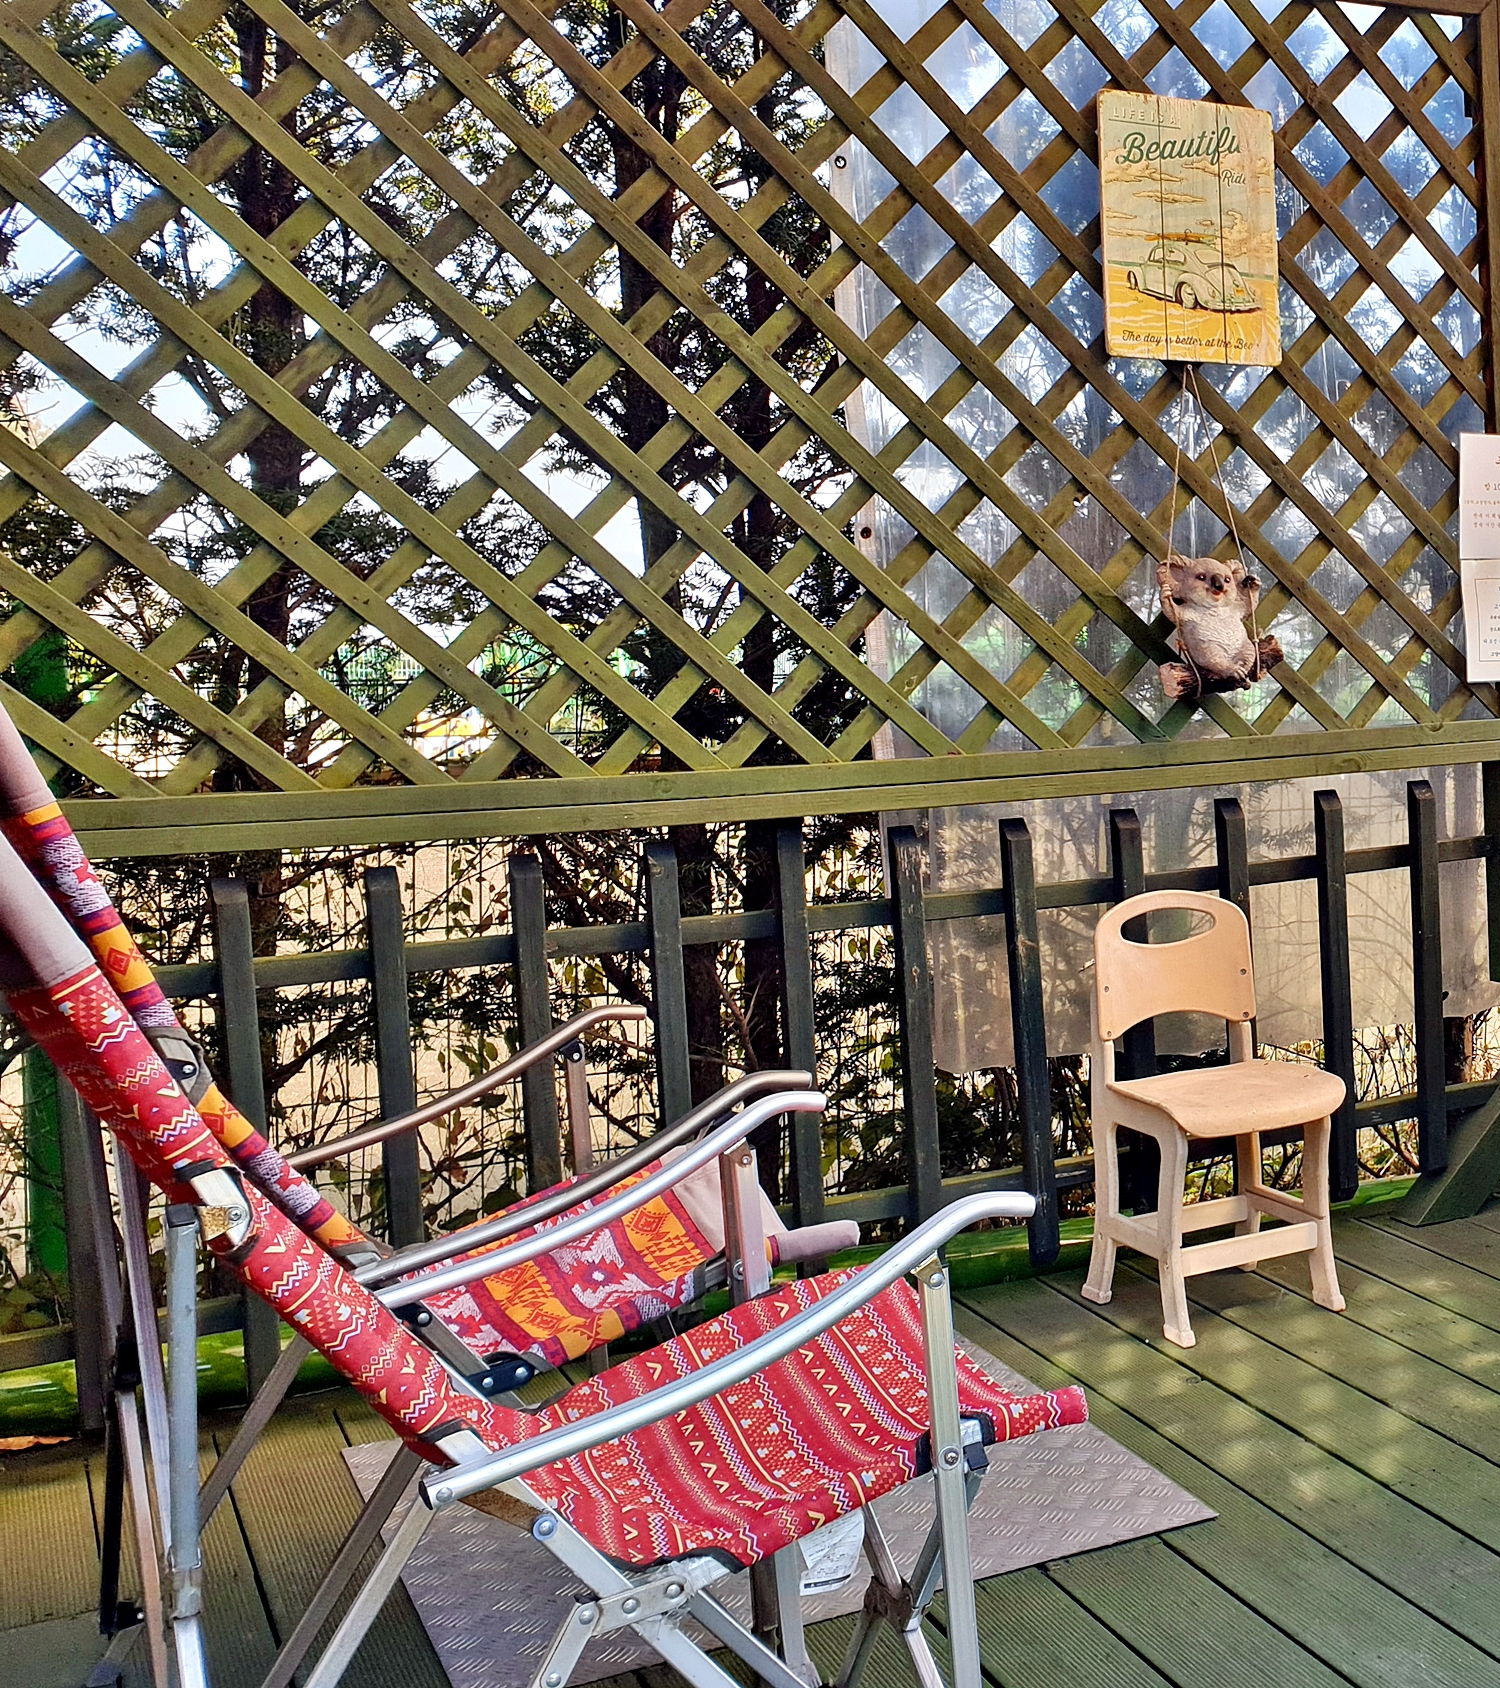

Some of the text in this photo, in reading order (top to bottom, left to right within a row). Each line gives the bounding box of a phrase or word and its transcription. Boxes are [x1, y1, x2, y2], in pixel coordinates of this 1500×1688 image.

[1113, 106, 1178, 125] LIFE IS A
[1115, 126, 1241, 166] Beautifu
[1122, 329, 1142, 342] The
[1143, 332, 1163, 346] day
[1175, 335, 1203, 346] better
[1204, 337, 1216, 347] at
[1217, 337, 1232, 349] the
[1233, 338, 1255, 350] Bea
